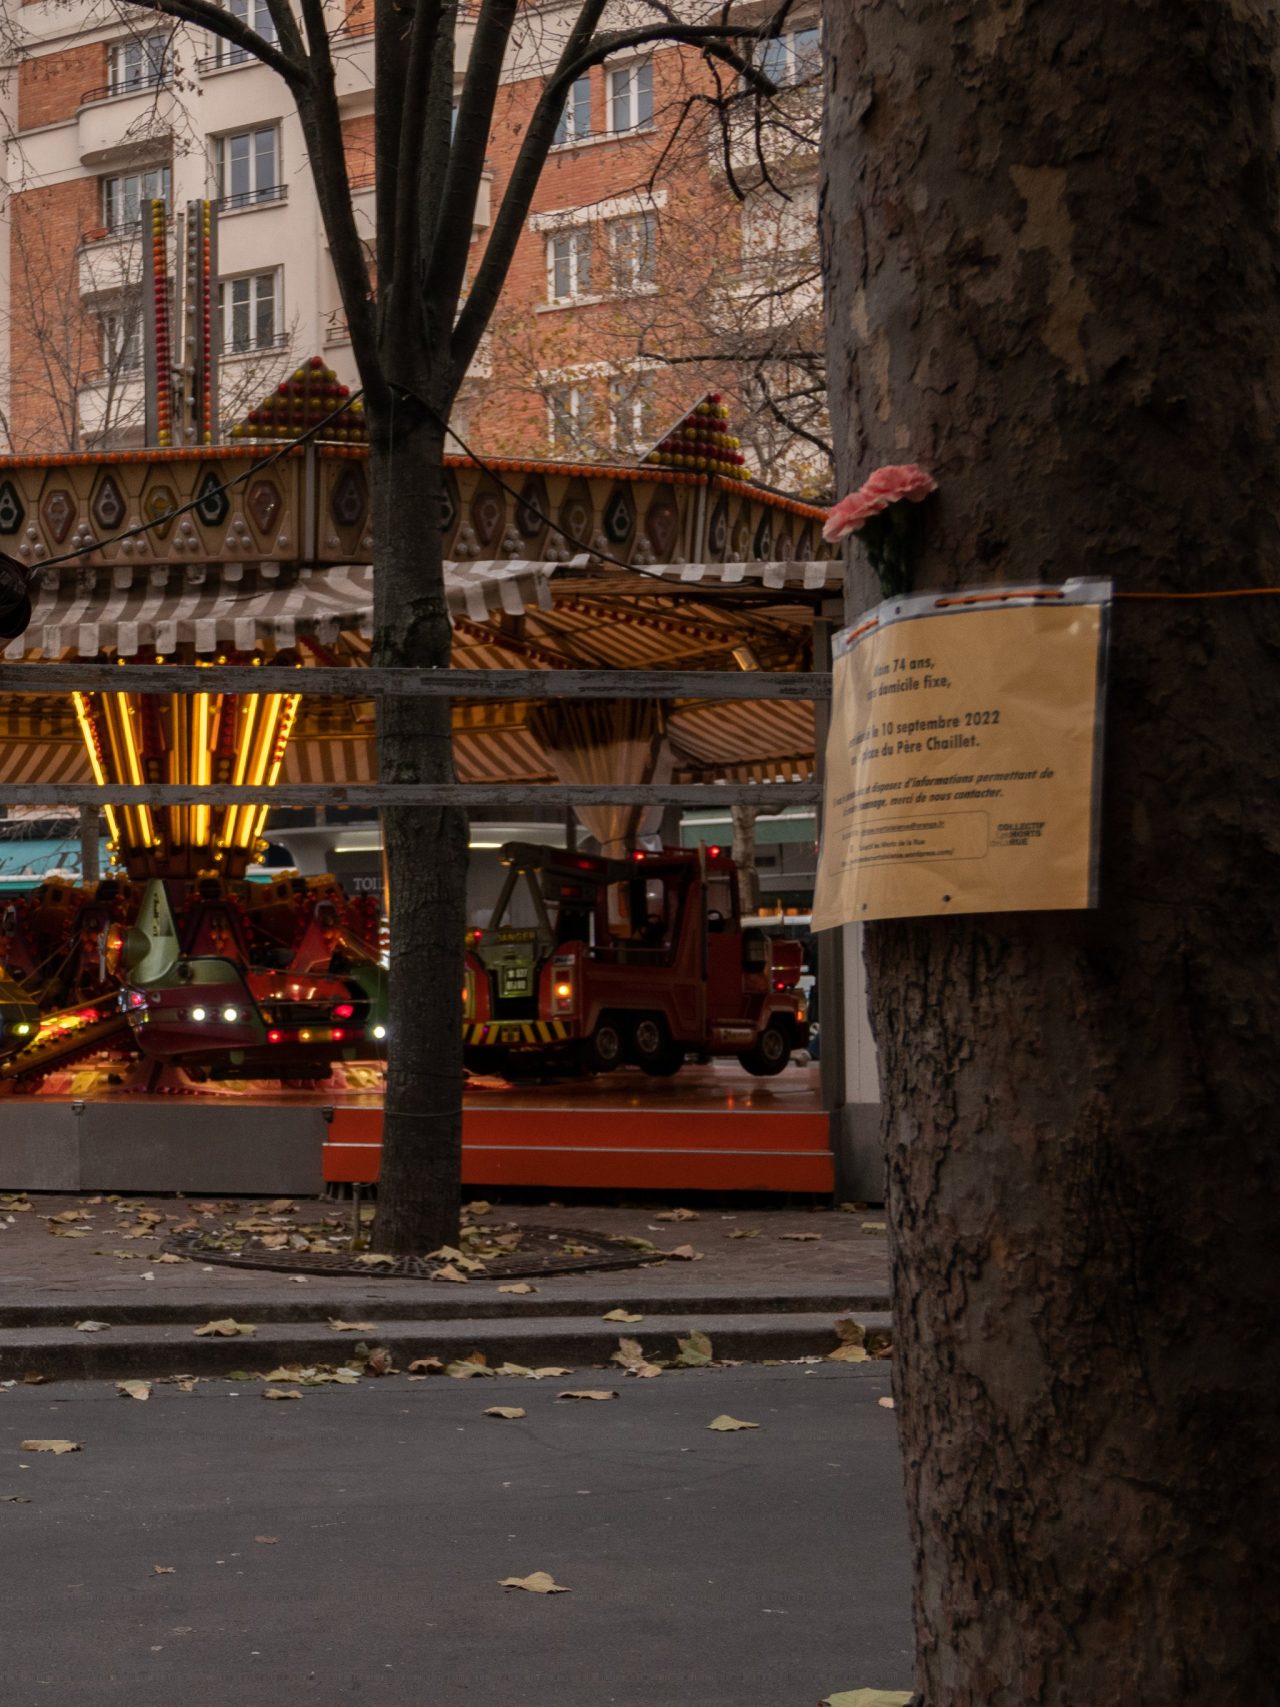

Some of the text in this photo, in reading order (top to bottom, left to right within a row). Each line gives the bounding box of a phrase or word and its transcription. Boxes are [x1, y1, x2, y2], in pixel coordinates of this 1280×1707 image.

[893, 658, 905, 672] 74
[909, 657, 934, 670] ans,
[879, 678, 919, 697] domicile
[924, 675, 951, 689] fixe,
[882, 721, 893, 736] 10
[896, 715, 960, 735] septembre
[965, 710, 1000, 726] 2022
[881, 742, 893, 757] du
[897, 740, 922, 755] Père
[926, 733, 980, 751] Chaillet.
[904, 773, 974, 789] d'informations
[975, 769, 1037, 785] permettant
[1039, 767, 1054, 779] de
[915, 792, 927, 803] de
[929, 792, 952, 802] nous
[954, 788, 1003, 801] contacter.
